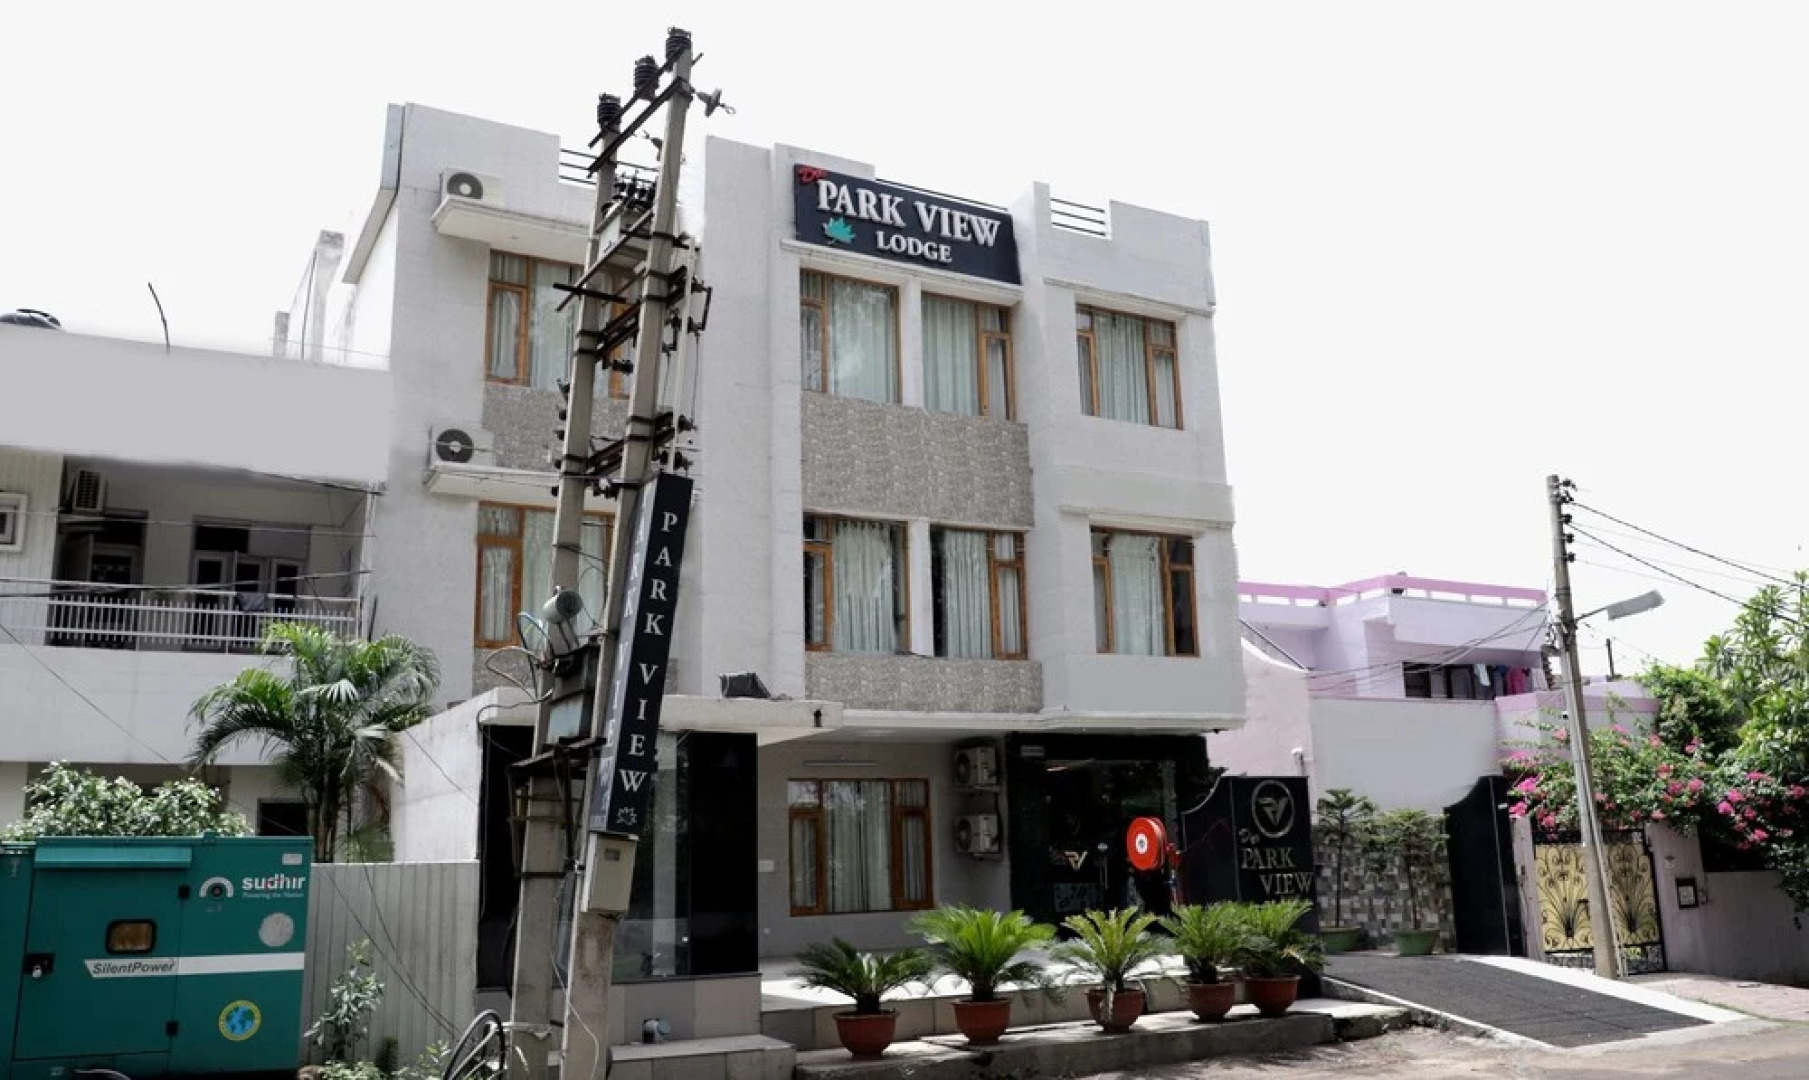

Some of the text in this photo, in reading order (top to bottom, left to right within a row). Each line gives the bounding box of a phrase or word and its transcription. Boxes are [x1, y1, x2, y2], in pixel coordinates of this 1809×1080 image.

[817, 179, 1001, 247] PARK VIEW
[875, 231, 952, 263] LODGE
[619, 511, 678, 793] PARK VIEW
[1241, 847, 1296, 870] PARK
[242, 873, 306, 890] sudhir
[1259, 872, 1314, 896] VIEW
[92, 961, 175, 975] SilentPower
